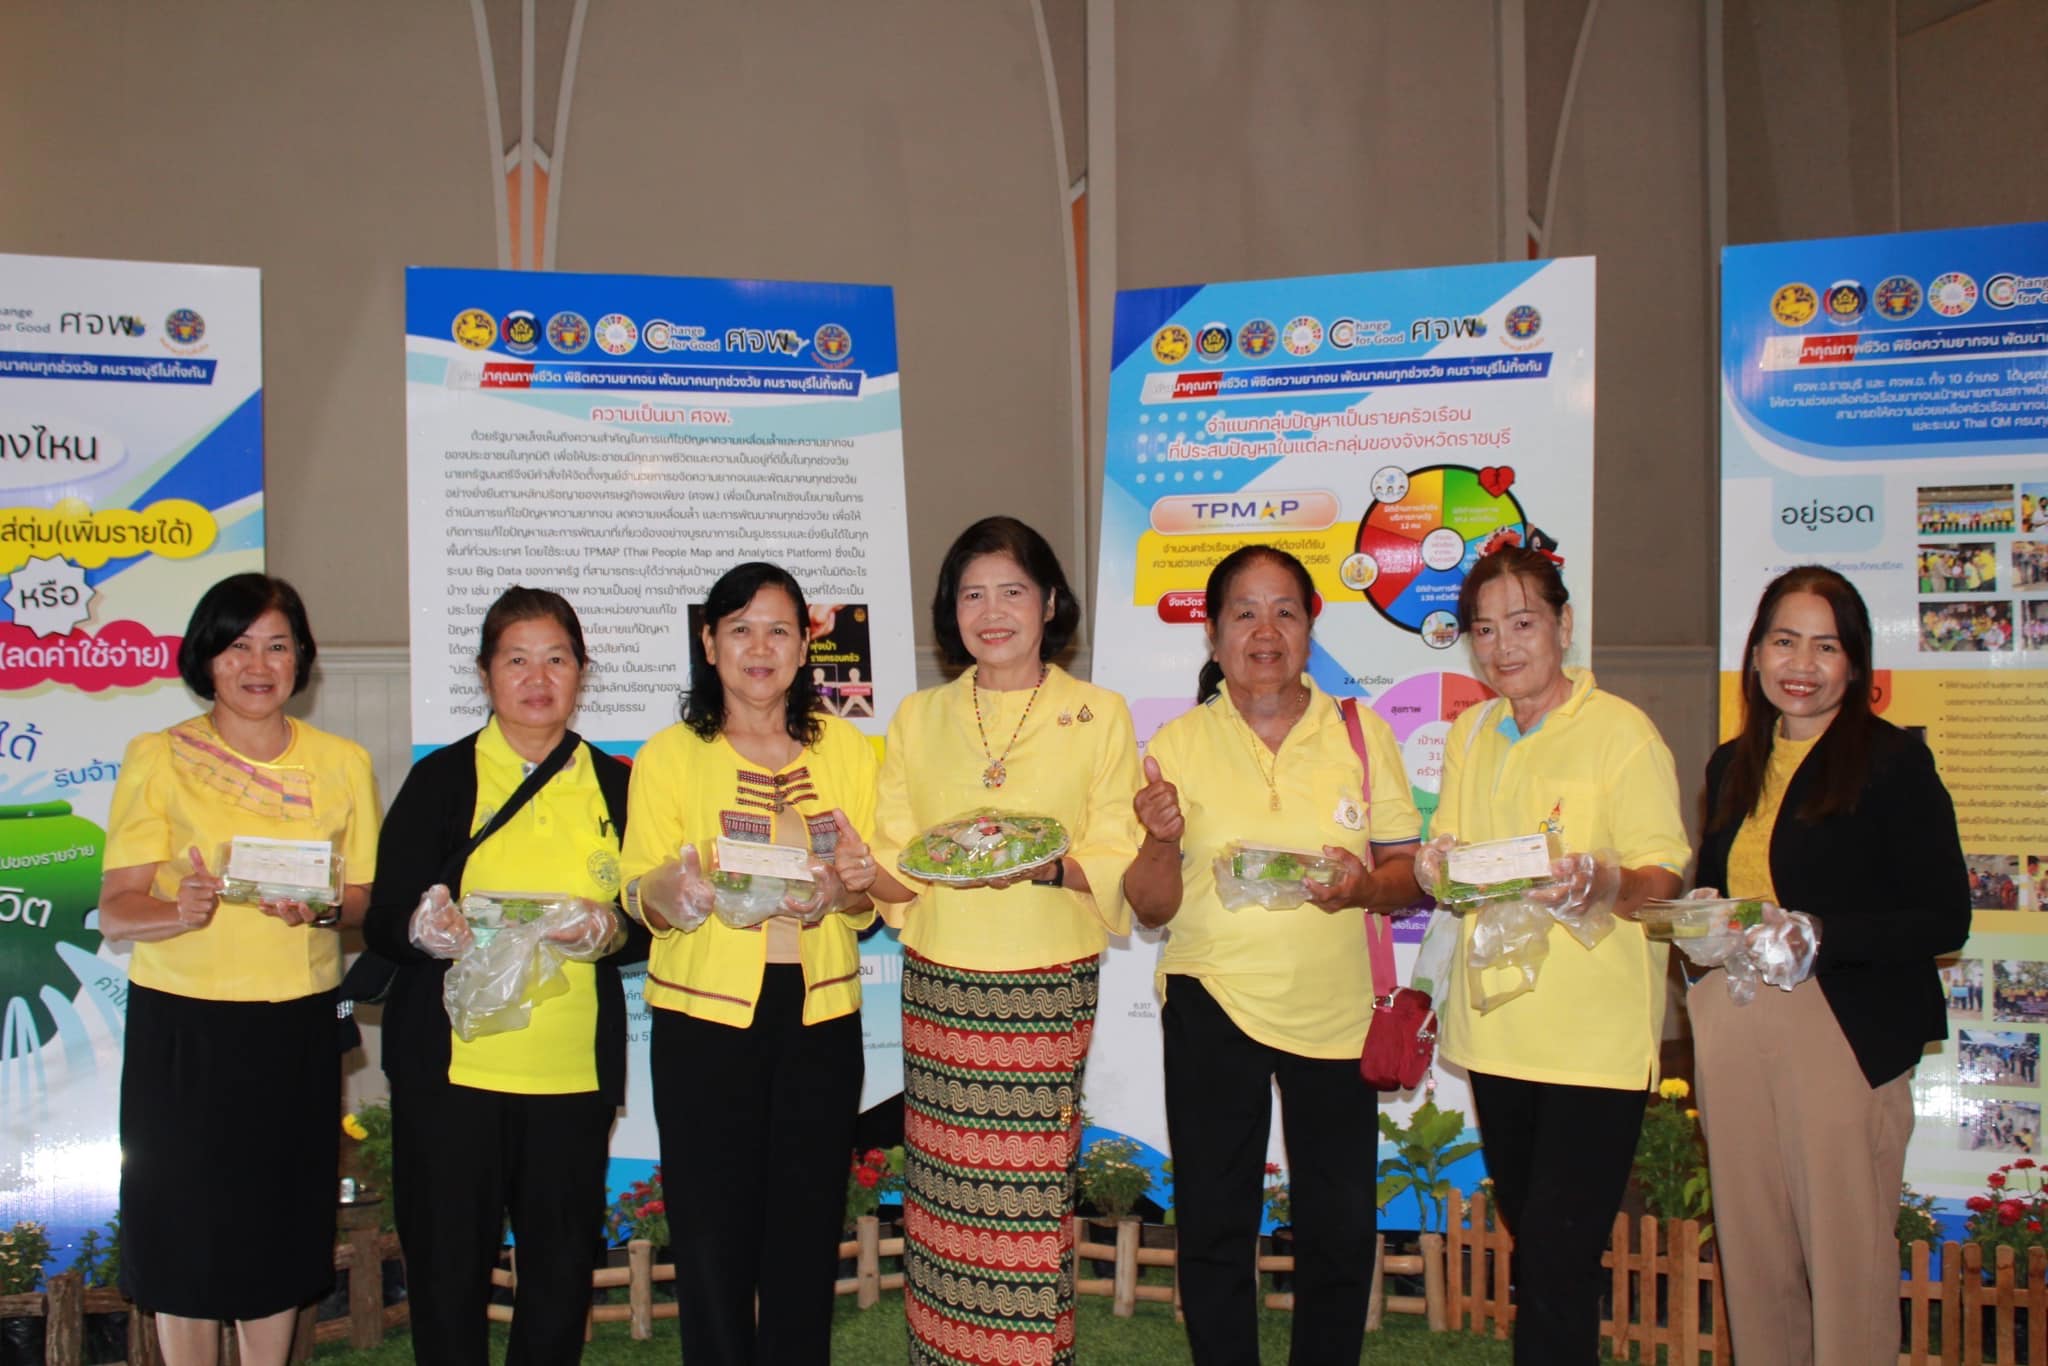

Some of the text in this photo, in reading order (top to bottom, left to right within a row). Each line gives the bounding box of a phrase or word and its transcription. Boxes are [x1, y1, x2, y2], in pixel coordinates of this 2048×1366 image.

[592, 403, 732, 425] ความเป็นมา ศจพ.
[1207, 406, 1472, 437] จำแนกกลุ่มปัญหาเป็นรายครัวเรือน
[1168, 427, 1513, 460] ที่ประสบปัญหาในแต่ละกลุ่มของจังหวัดราชบุรี
[1781, 498, 1875, 532] อยู่รอด
[584, 547, 620, 557] TPMAP
[497, 566, 522, 576] Data
[19, 579, 80, 610] หรือ
[0, 638, 170, 670] (ลดค่าใช้จ่าย)
[54, 757, 122, 788] รับจ้า
